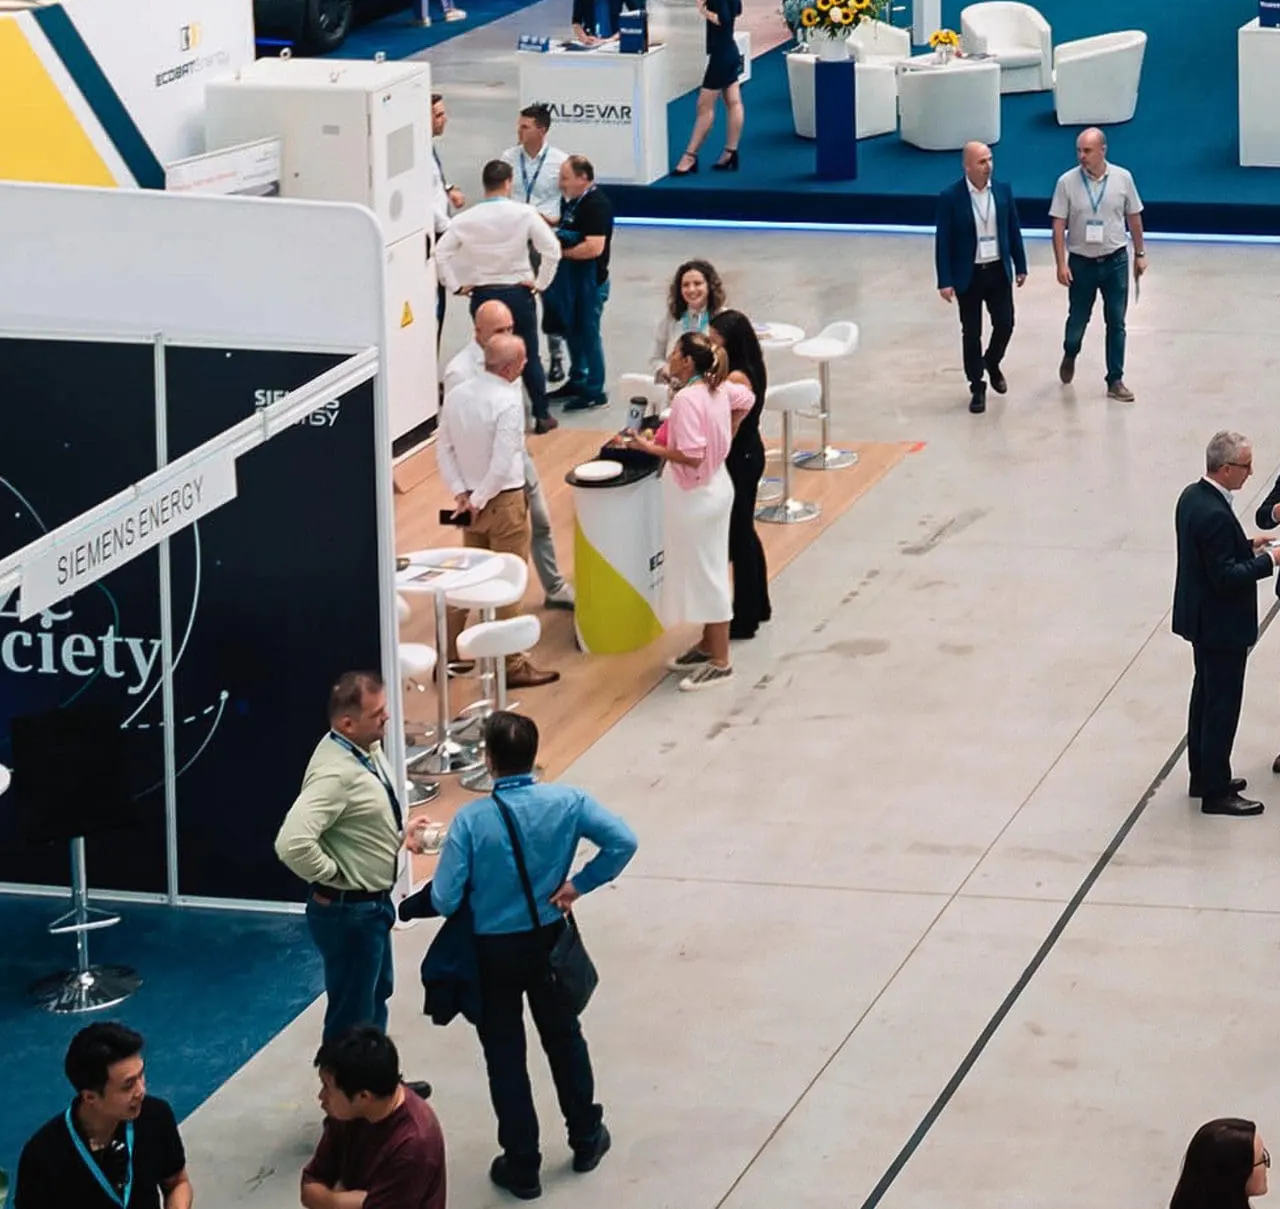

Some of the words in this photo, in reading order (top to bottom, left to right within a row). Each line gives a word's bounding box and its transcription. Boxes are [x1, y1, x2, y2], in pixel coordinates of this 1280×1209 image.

[254, 389, 340, 409] SIES
[57, 517, 136, 585] SIEMENS
[139, 475, 204, 538] ENERGY
[1, 624, 164, 695] ciety
